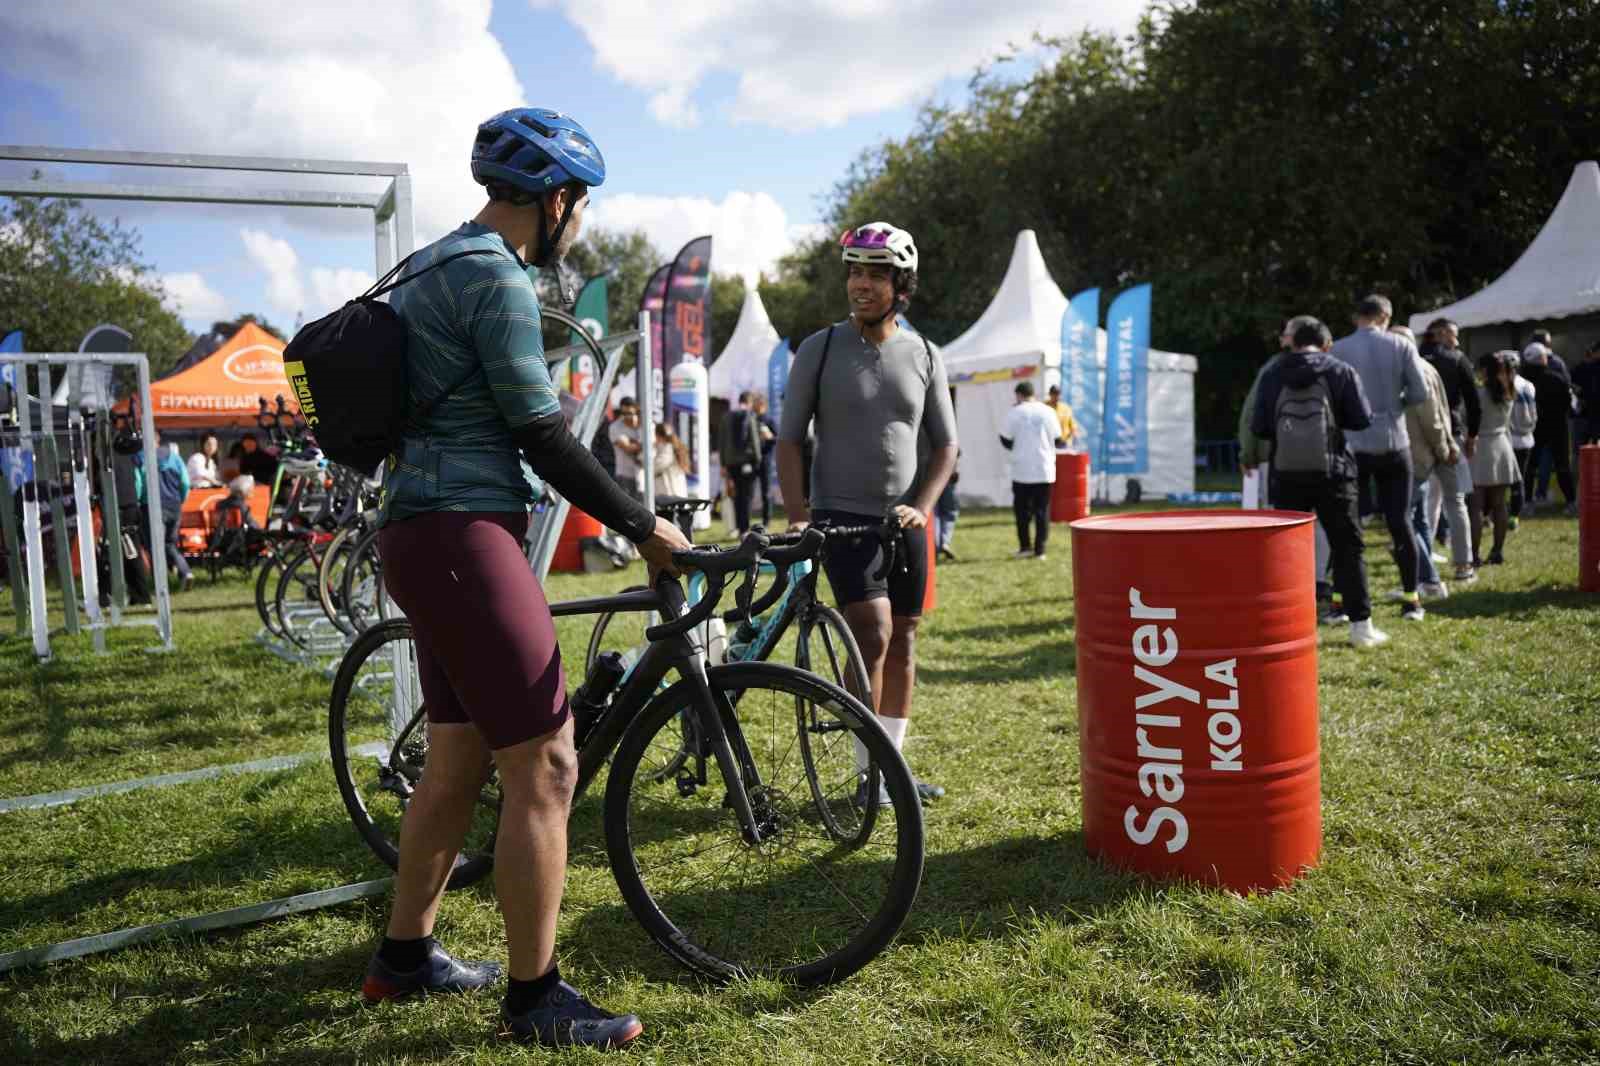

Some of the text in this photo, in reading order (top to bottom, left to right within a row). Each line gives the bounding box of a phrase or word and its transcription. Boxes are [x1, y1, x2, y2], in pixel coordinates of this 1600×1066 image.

[1118, 316, 1133, 408] HOSPITAL
[1124, 586, 1200, 853] Sarıyer
[1204, 657, 1243, 771] KOLA
